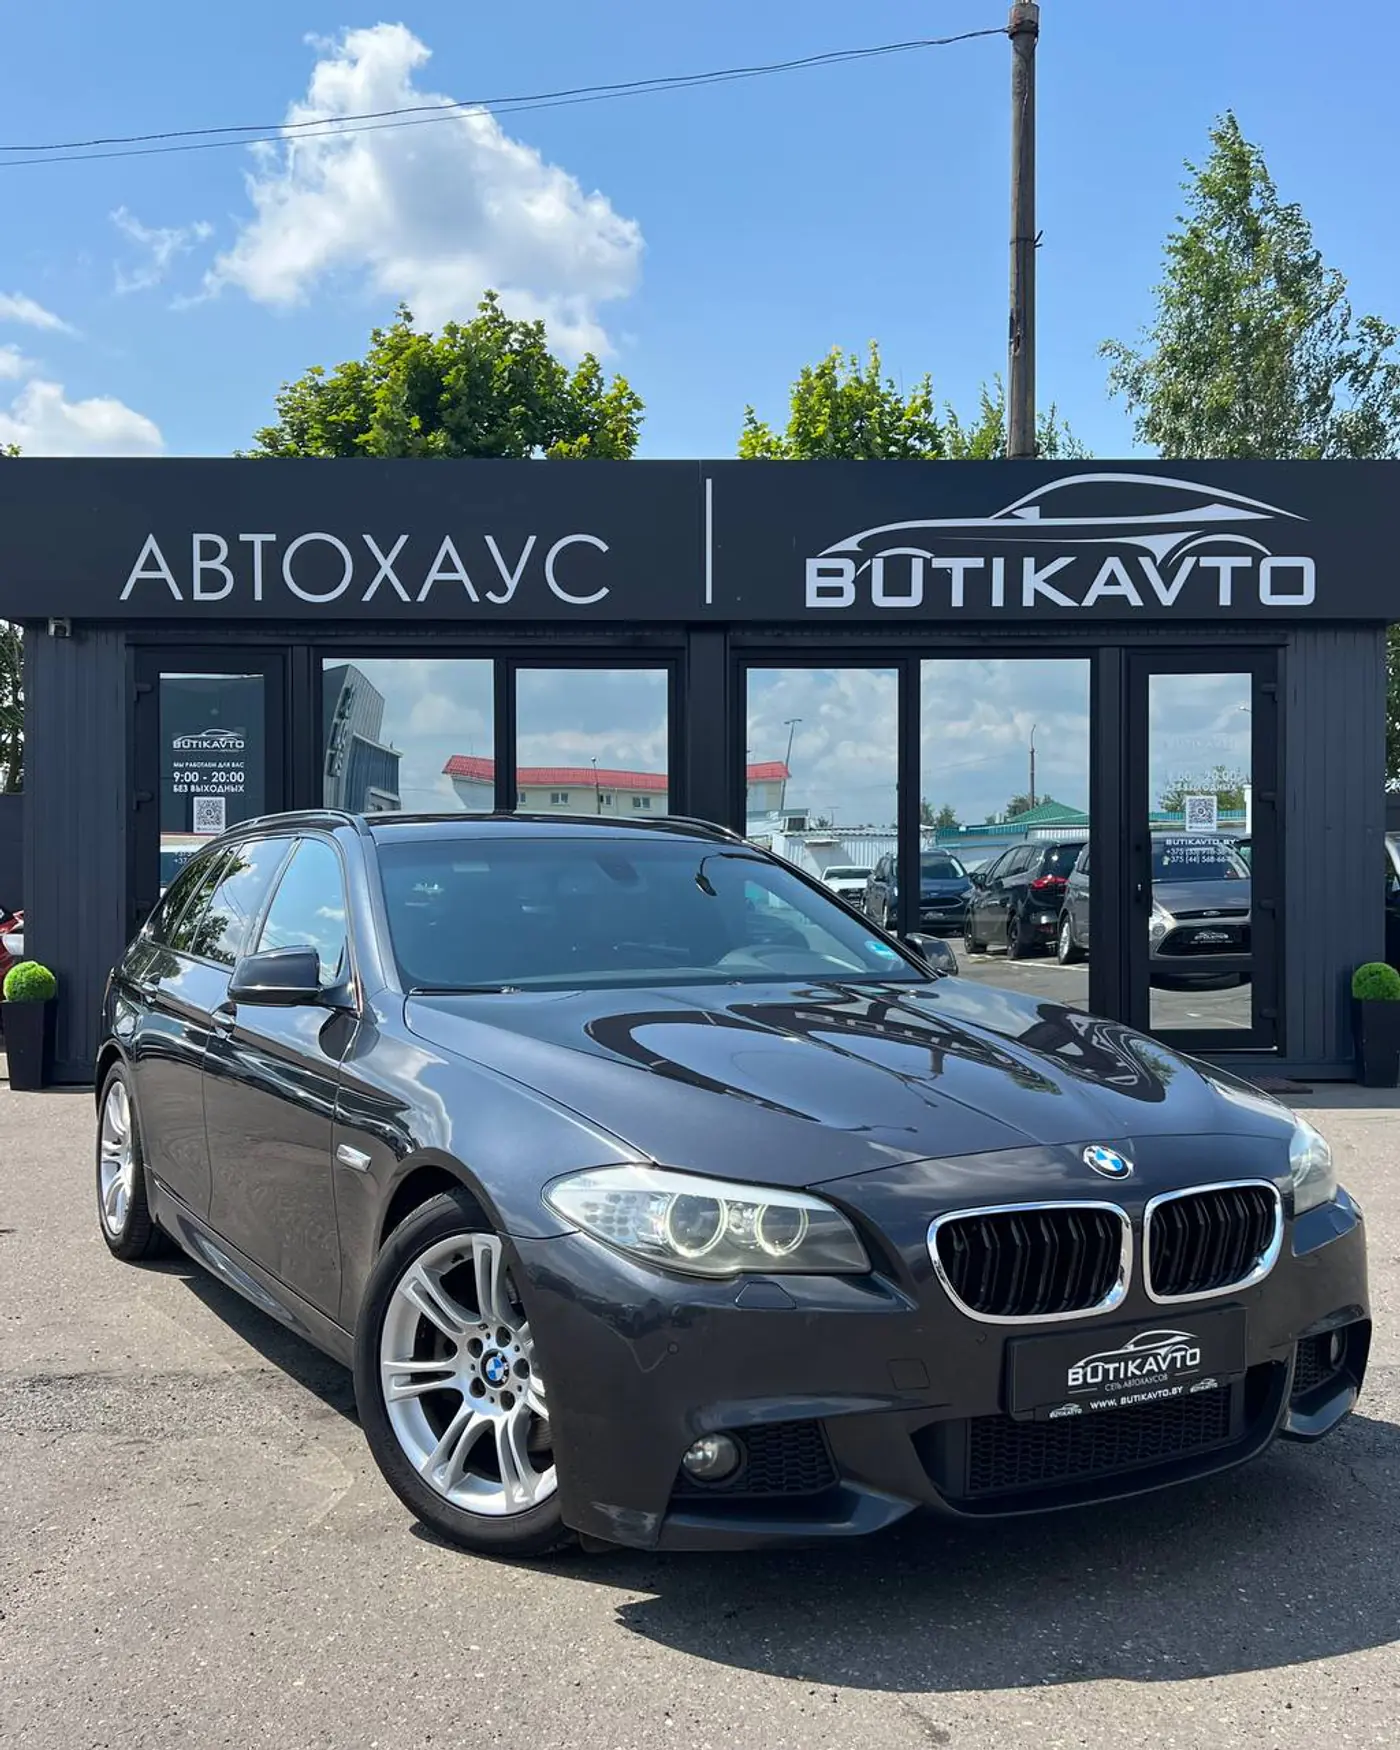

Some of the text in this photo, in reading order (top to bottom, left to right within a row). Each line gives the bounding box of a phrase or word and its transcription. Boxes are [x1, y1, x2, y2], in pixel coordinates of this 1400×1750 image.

[119, 532, 611, 604] АВТОХАУС
[805, 556, 1316, 608] BUTIKAVTO
[172, 739, 245, 749] BUTIKAVTO
[217, 761, 231, 769] ДЛЯ
[173, 771, 199, 783] 9:00
[211, 771, 245, 783] 20:00
[173, 784, 245, 793] БЕЗ ВЫХОДНЫХ
[1068, 1348, 1201, 1386] BUTIKAVTO
[1104, 1373, 1168, 1392] СЕТЬ АВТОХАУСОВ
[1120, 1386, 1183, 1406] BUTIKAVTO.BY
